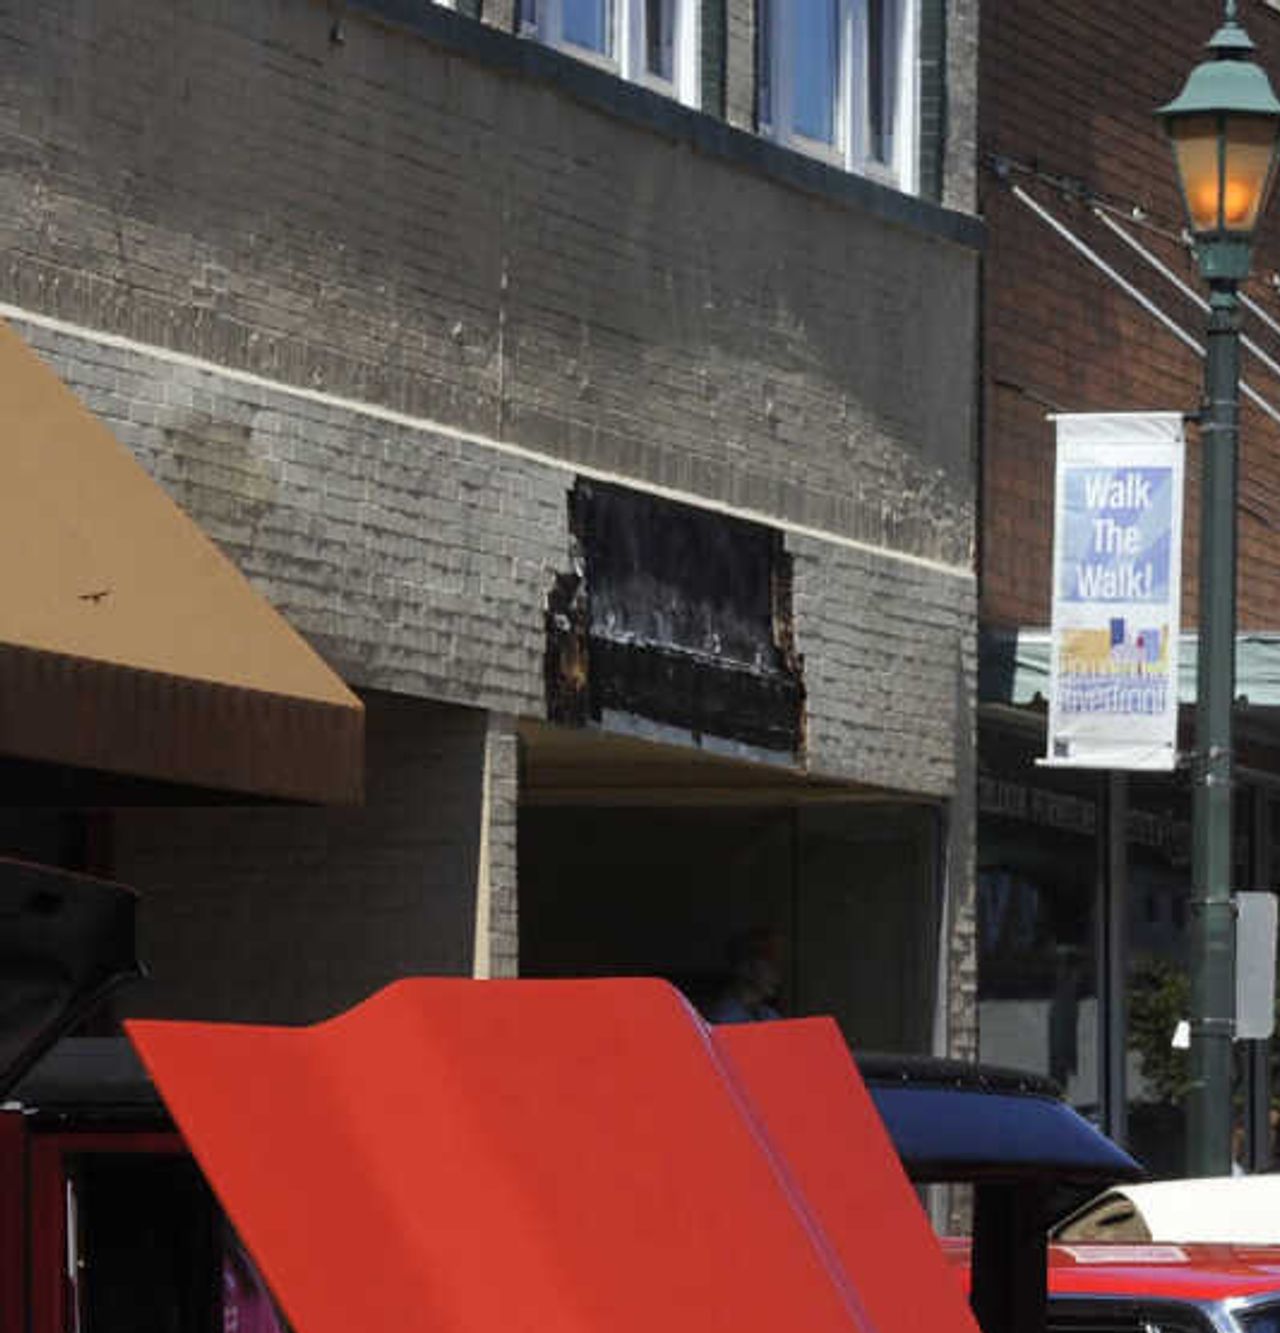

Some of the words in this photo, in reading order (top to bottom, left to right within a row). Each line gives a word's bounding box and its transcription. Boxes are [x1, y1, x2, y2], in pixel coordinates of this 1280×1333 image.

[1085, 472, 1152, 509] Walk
[1092, 518, 1141, 554] The
[1076, 561, 1152, 599] Walk!
